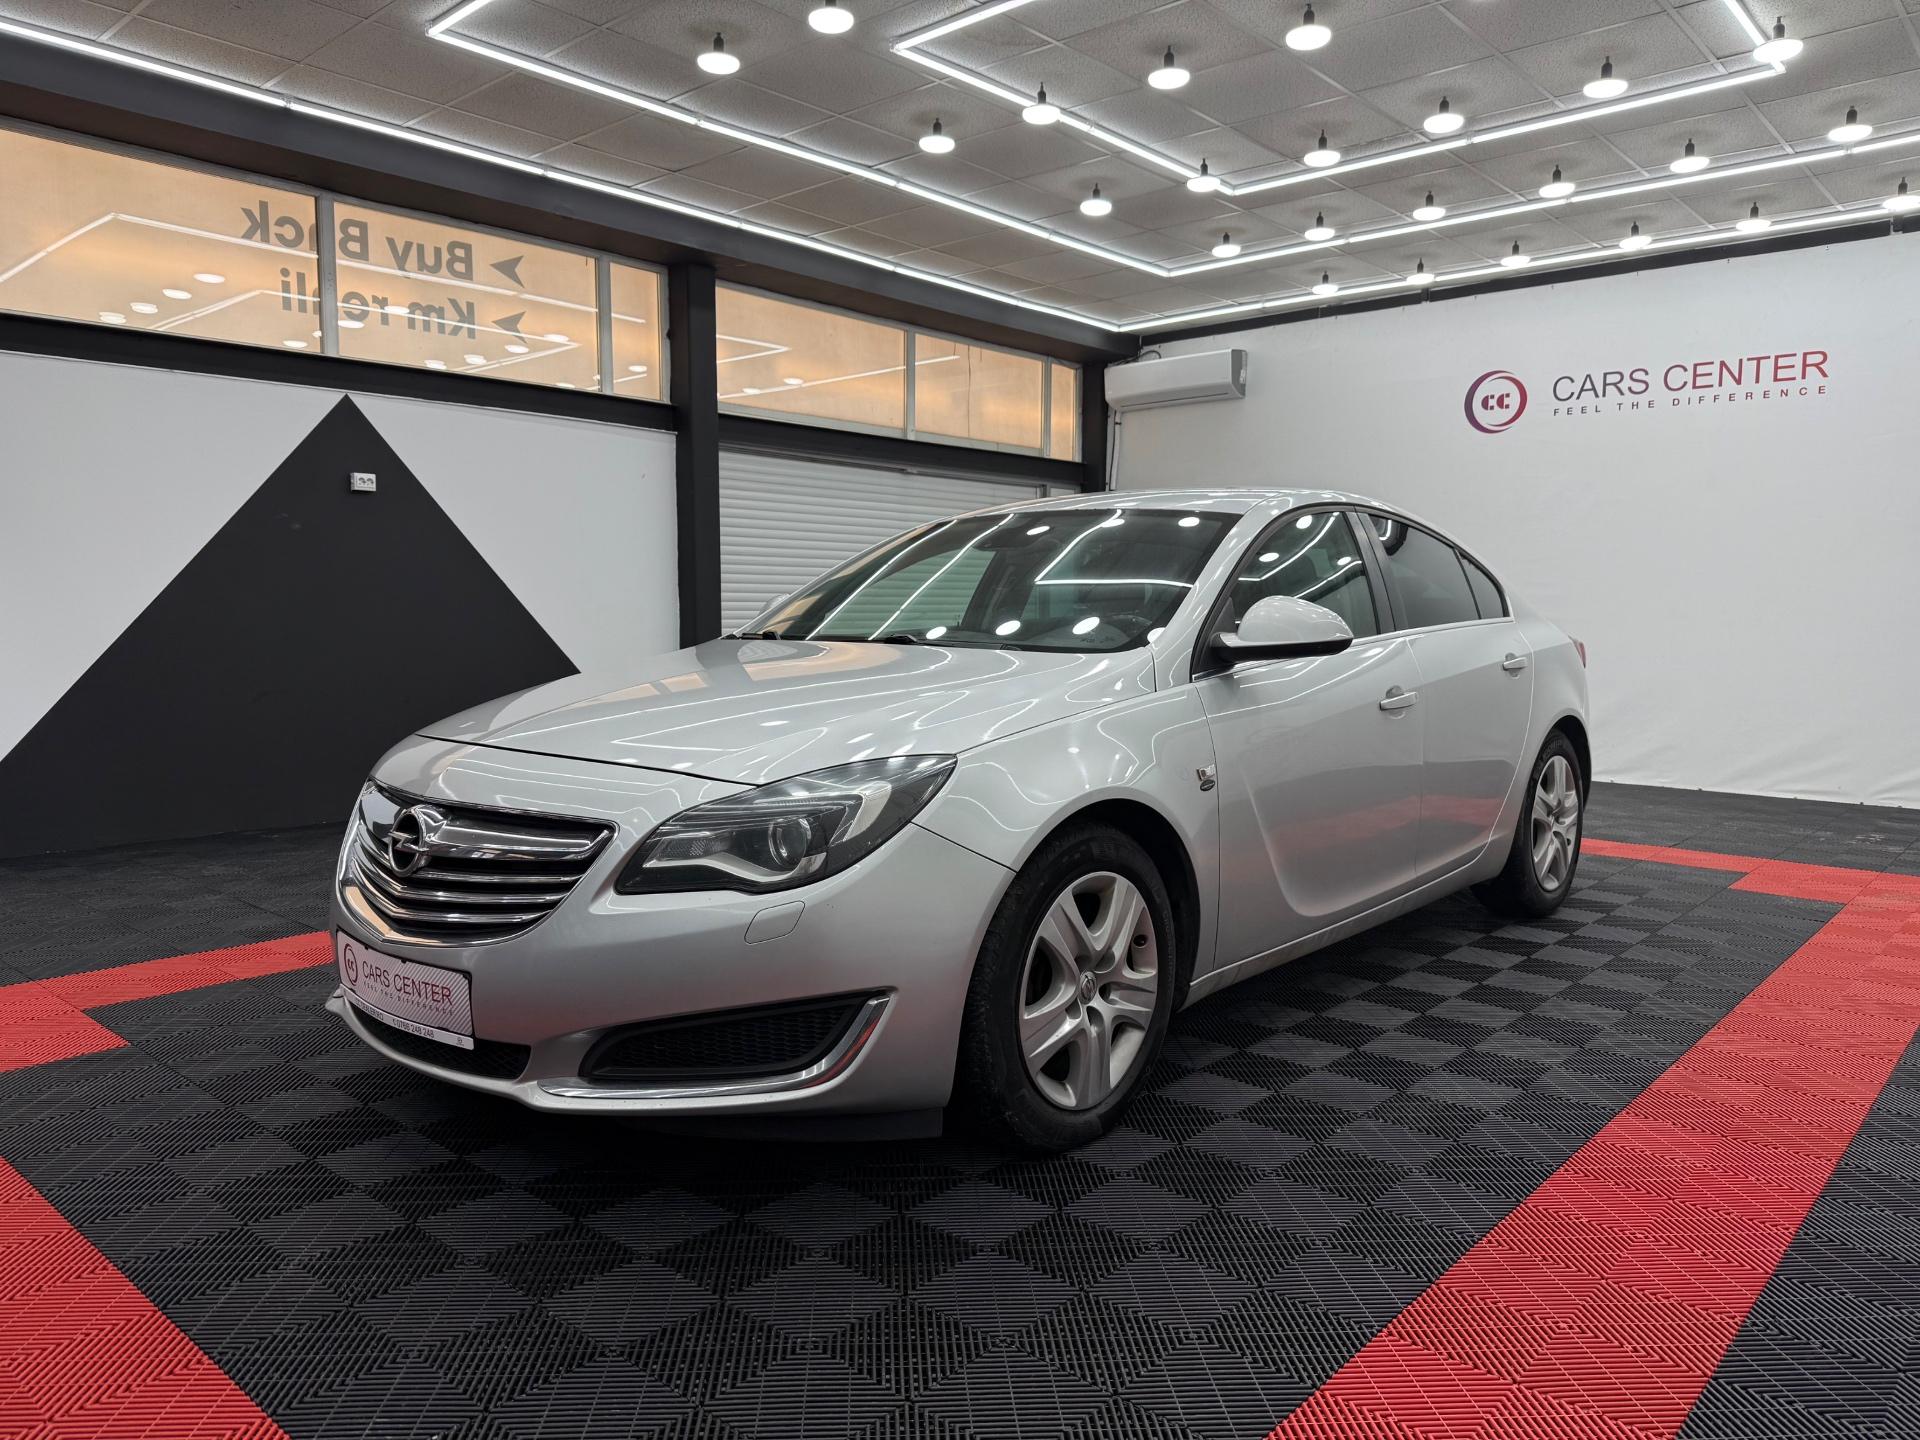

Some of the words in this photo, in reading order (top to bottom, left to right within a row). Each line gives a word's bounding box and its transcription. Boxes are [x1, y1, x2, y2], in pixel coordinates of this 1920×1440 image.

[1552, 367, 1650, 402] CARS
[1662, 350, 1830, 393] CENTER
[1553, 405, 1602, 417] FEEL
[1617, 400, 1656, 412] THE
[1672, 385, 1828, 407] DIFFERENCE
[362, 960, 391, 988] CARS
[393, 974, 453, 1006] CENTER
